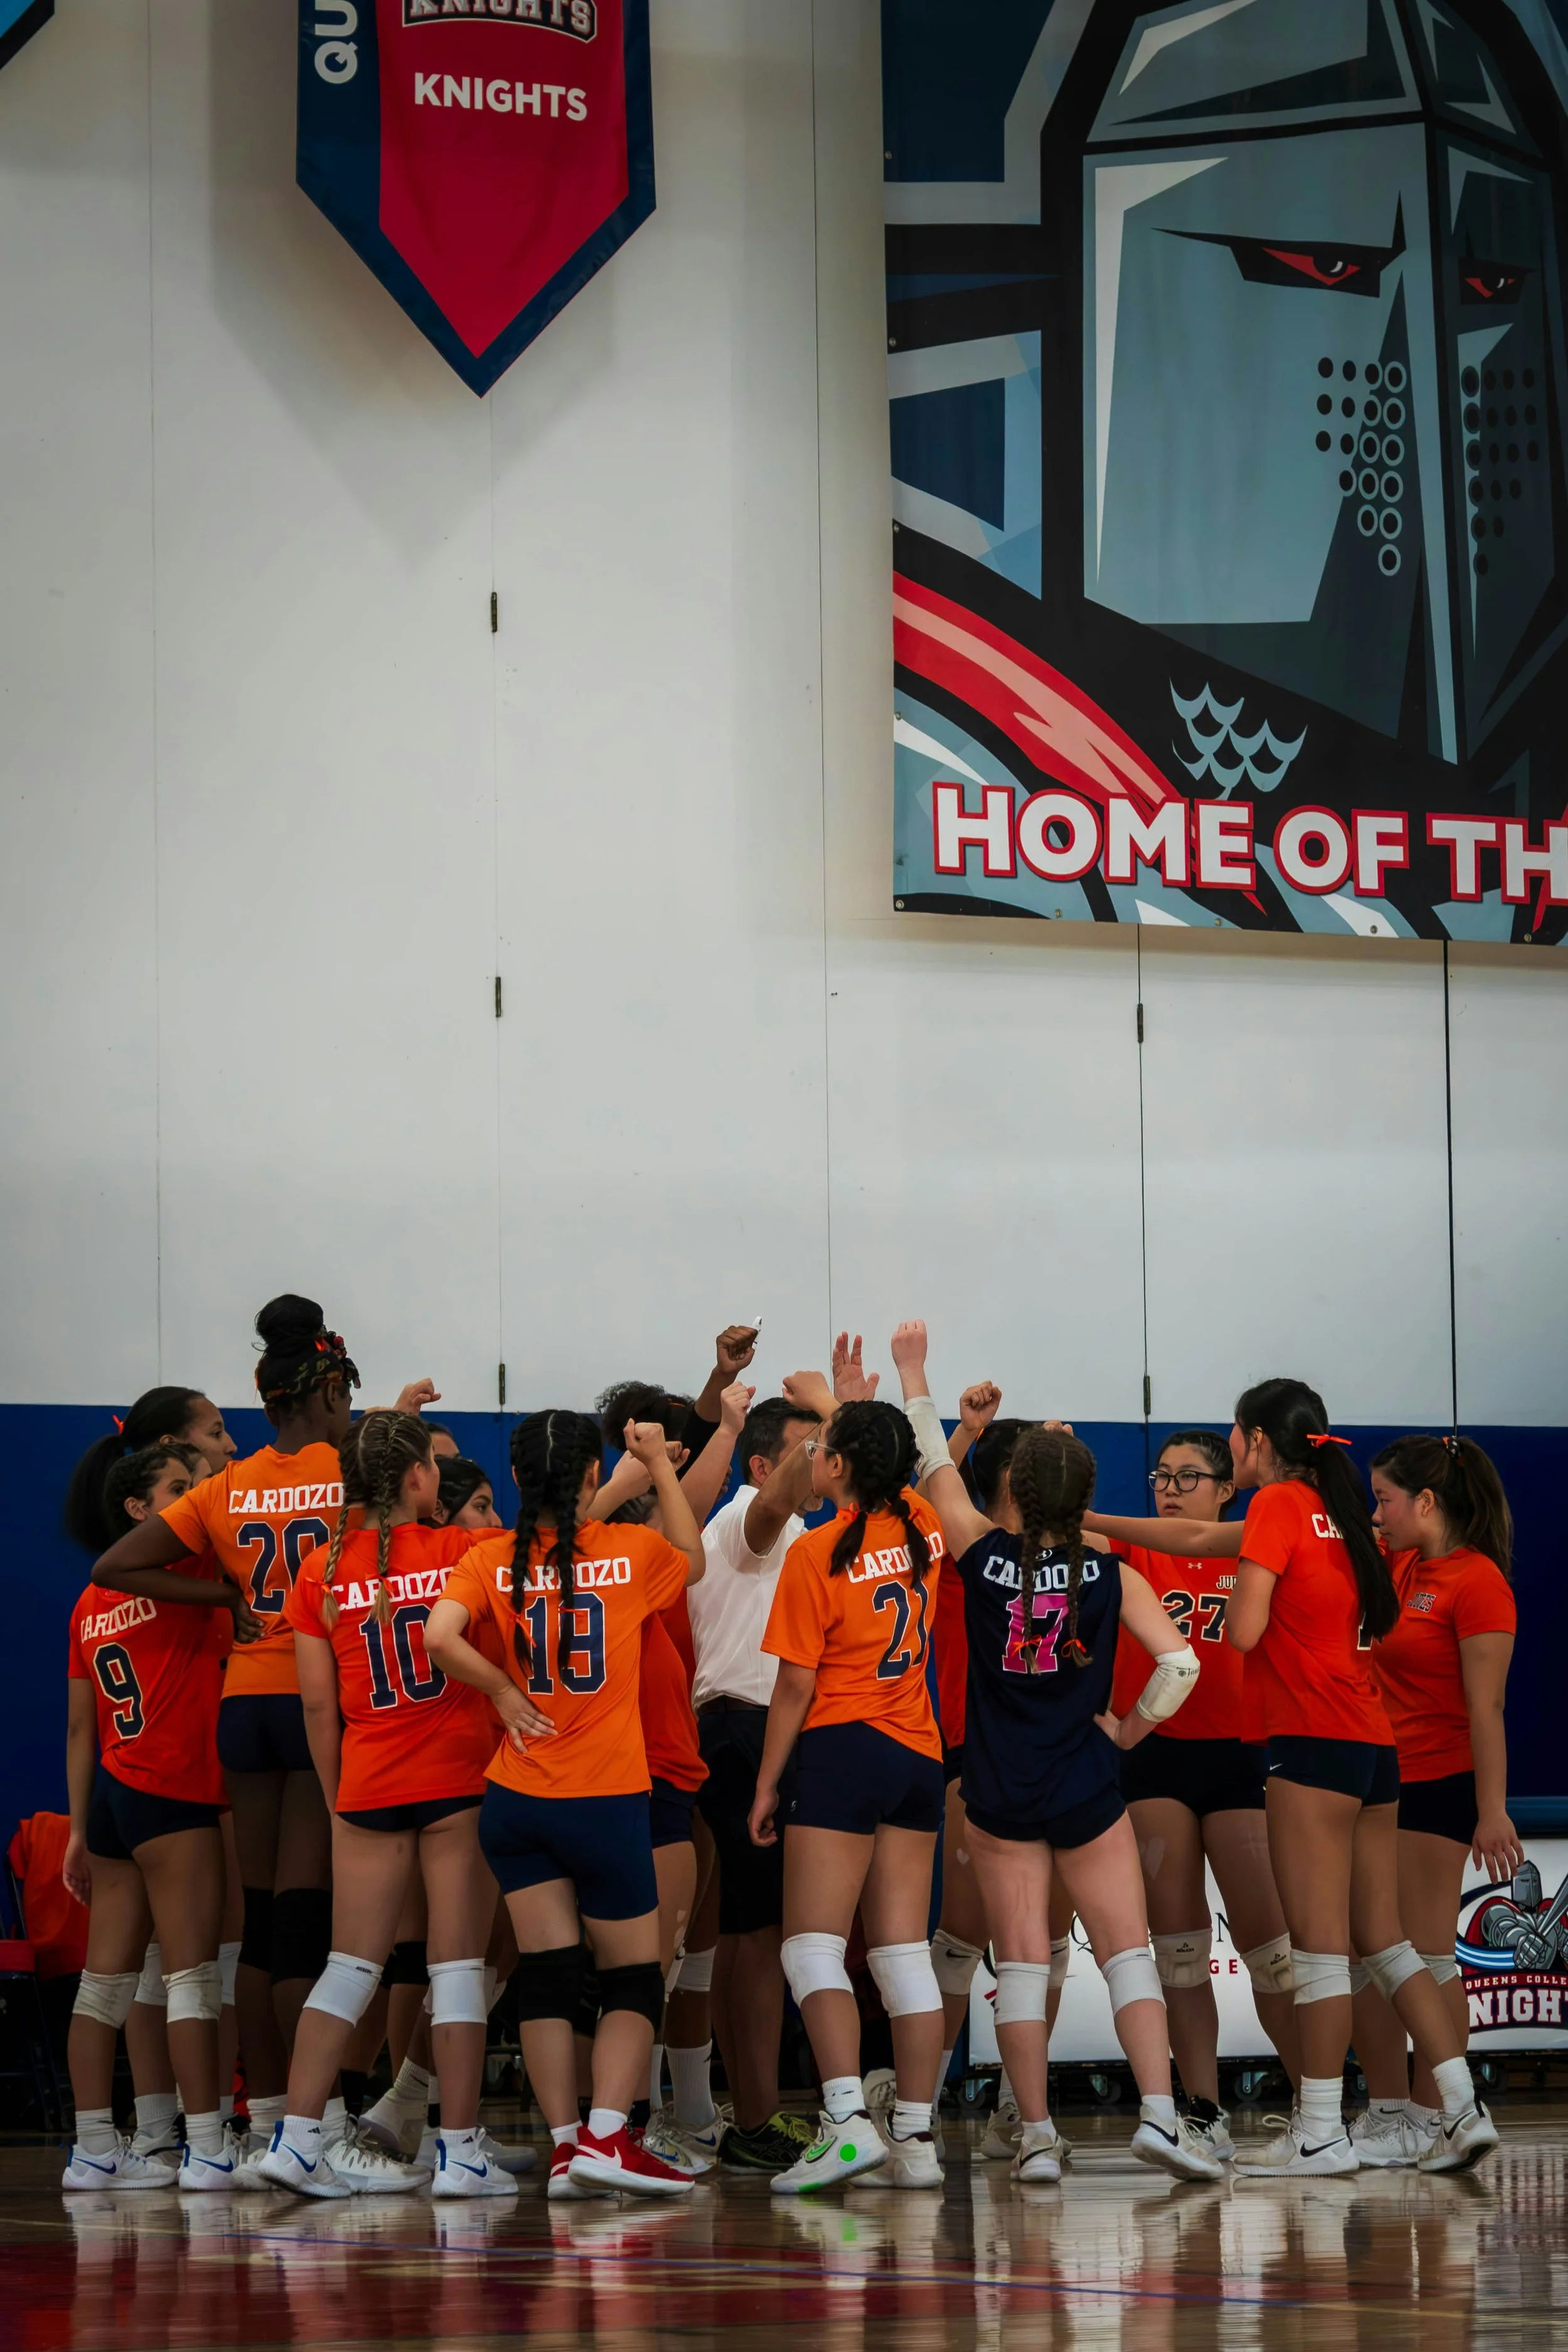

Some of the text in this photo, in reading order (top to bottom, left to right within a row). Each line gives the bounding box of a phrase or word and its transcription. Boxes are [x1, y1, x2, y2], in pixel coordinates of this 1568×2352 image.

[414, 72, 587, 121] KNIGHTS
[933, 781, 1568, 907] HOME OF TH
[229, 1482, 344, 1513] CARDOZO
[496, 1557, 632, 1592] CROZO
[845, 1531, 944, 1584] CARDO
[983, 1555, 1100, 1592] CADOO
[872, 1580, 929, 1681] 21
[1002, 1592, 1071, 1674] 17
[1161, 1589, 1229, 1643] 27
[359, 1604, 447, 1710] 10
[93, 1641, 145, 1740] 9
[1466, 1976, 1517, 1989] QUEENS
[1467, 1988, 1568, 2028] NIGH
